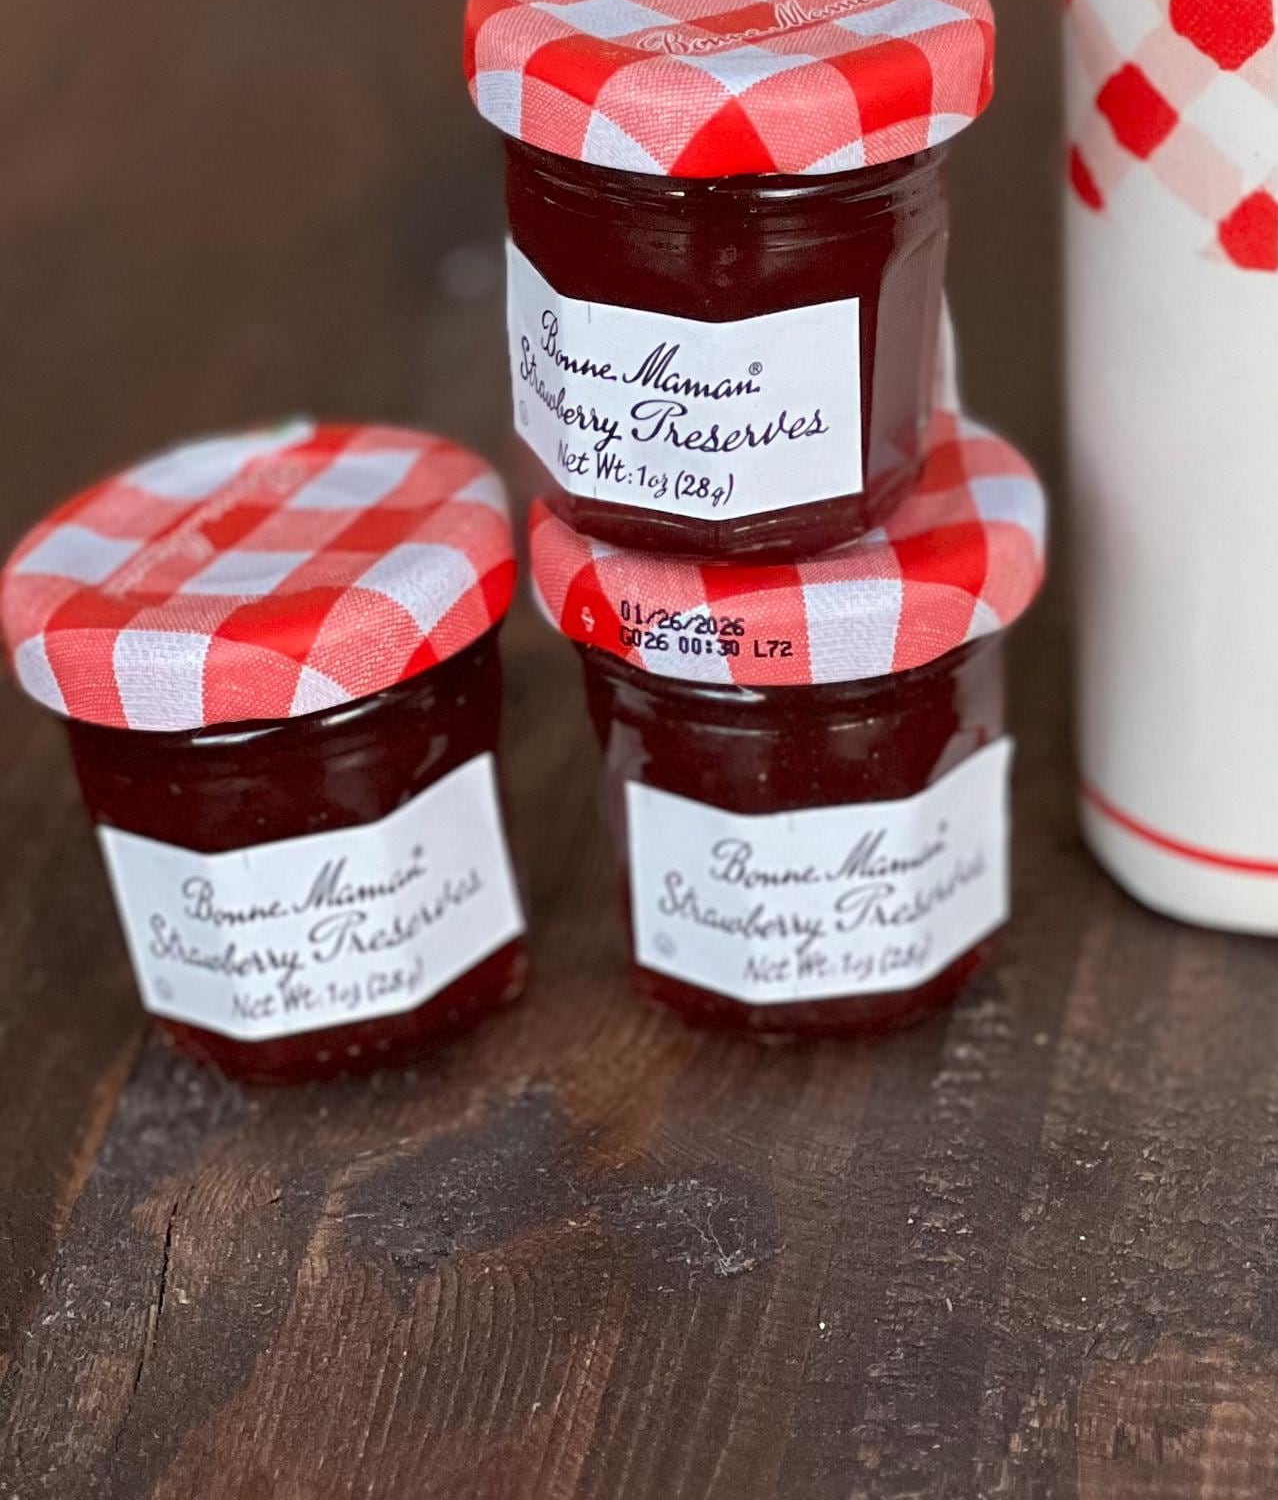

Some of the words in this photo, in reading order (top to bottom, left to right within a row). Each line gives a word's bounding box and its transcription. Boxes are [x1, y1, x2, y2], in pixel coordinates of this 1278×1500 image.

[638, 30, 763, 55] Bonne
[541, 309, 617, 381] Bonne
[520, 336, 622, 452] Strawberry
[631, 399, 828, 453] Preserves
[557, 440, 590, 475] Net
[674, 471, 734, 505] (28g)
[619, 627, 669, 651] G026
[678, 636, 740, 657] 00:30
[753, 639, 793, 658] L72
[620, 600, 745, 636] 01/26/2026
